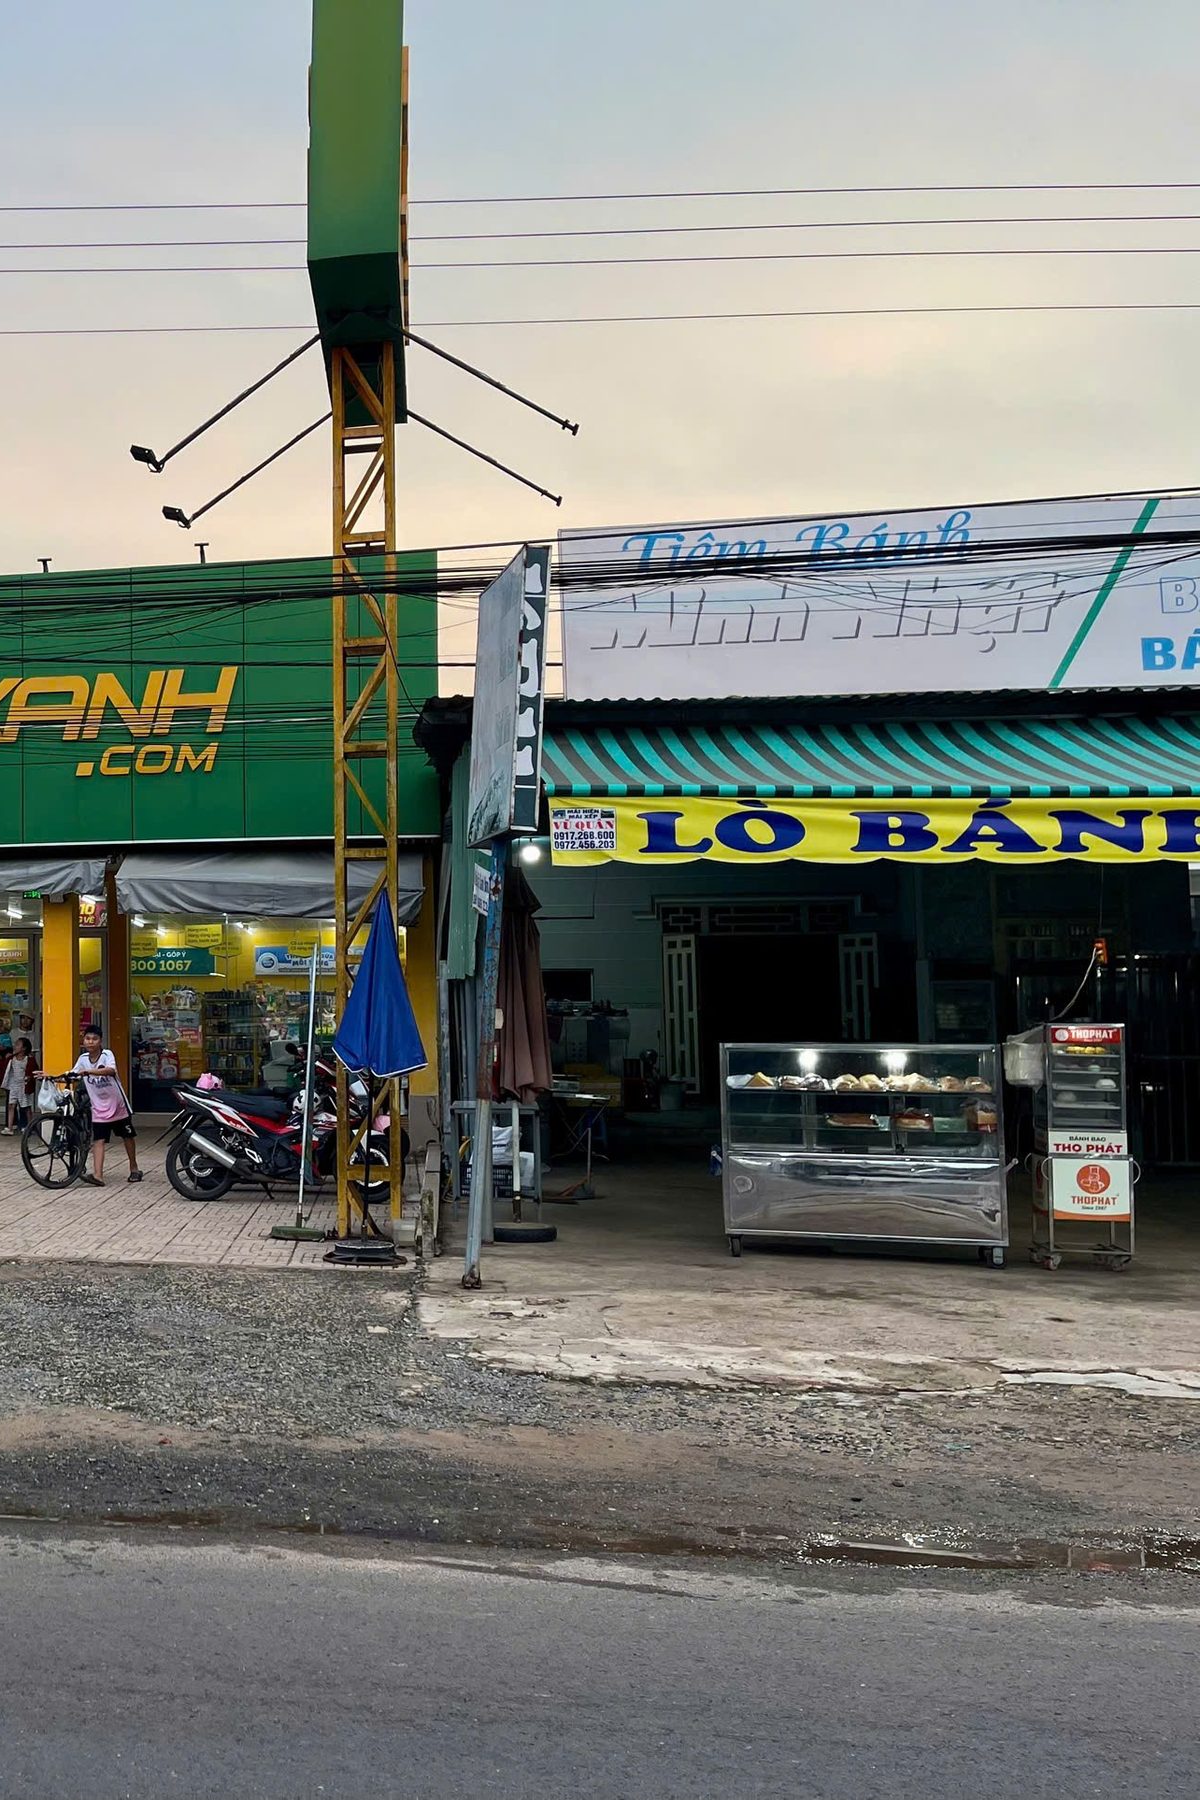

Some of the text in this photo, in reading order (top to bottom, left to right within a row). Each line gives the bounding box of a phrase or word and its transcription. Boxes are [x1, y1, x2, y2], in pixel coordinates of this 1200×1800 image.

[74, 741, 220, 777] .COM
[553, 831, 615, 840] 0917.268.600
[554, 840, 615, 849] 0972.456.203
[166, 950, 181, 958] GÓP
[159, 960, 192, 971] 1067
[1071, 1195, 1118, 1205] THOPHAT
